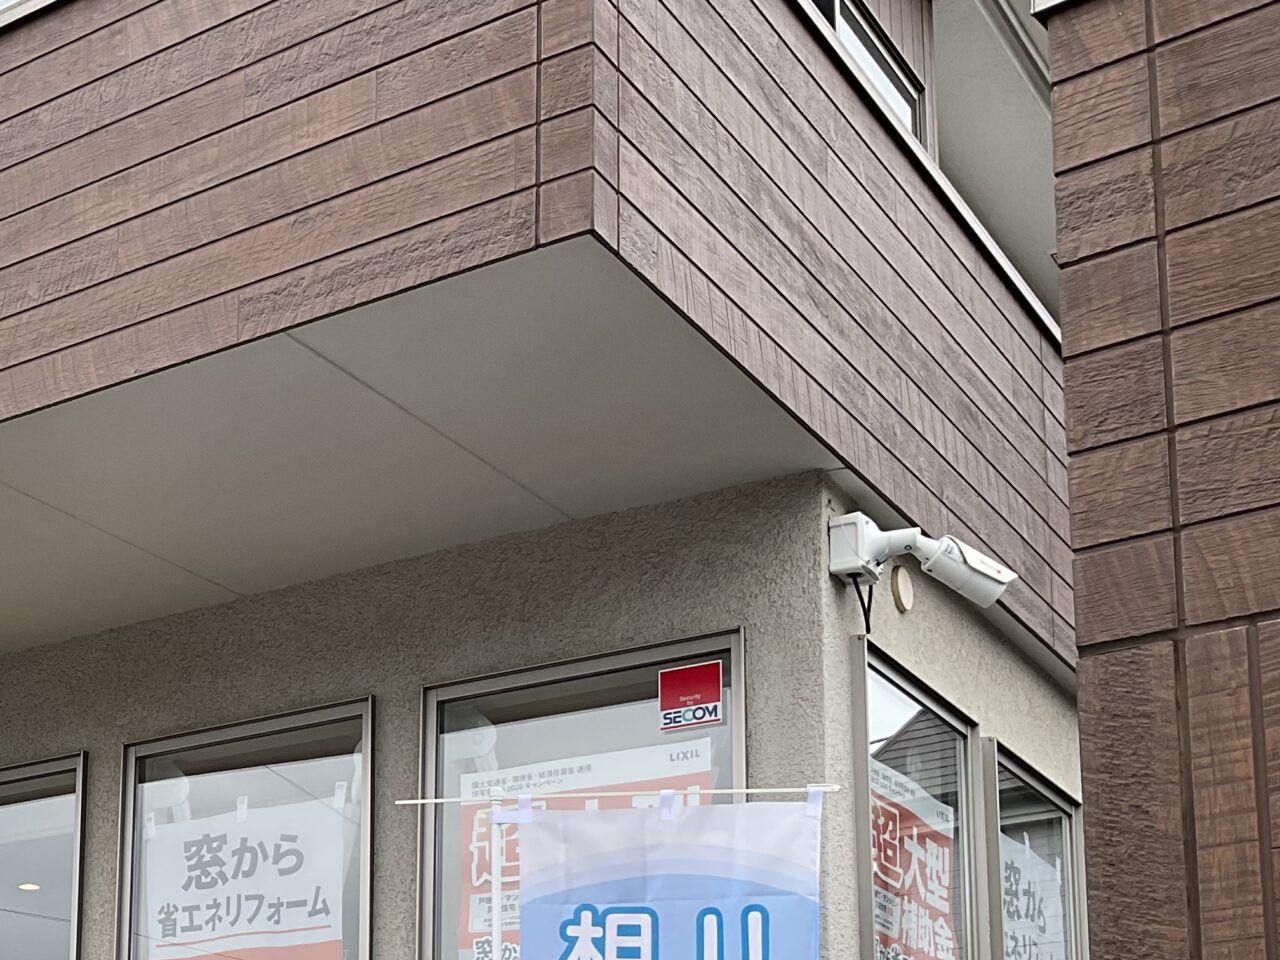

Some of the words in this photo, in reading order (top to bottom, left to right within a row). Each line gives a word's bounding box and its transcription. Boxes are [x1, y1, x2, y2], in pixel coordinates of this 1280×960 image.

[663, 704, 718, 725] SECOM
[680, 694, 701, 702] Security
[670, 748, 701, 762] LIXIL
[181, 832, 305, 892] 窓から
[157, 886, 332, 939] 省エネリフォーム
[1004, 860, 1047, 934] 窓から
